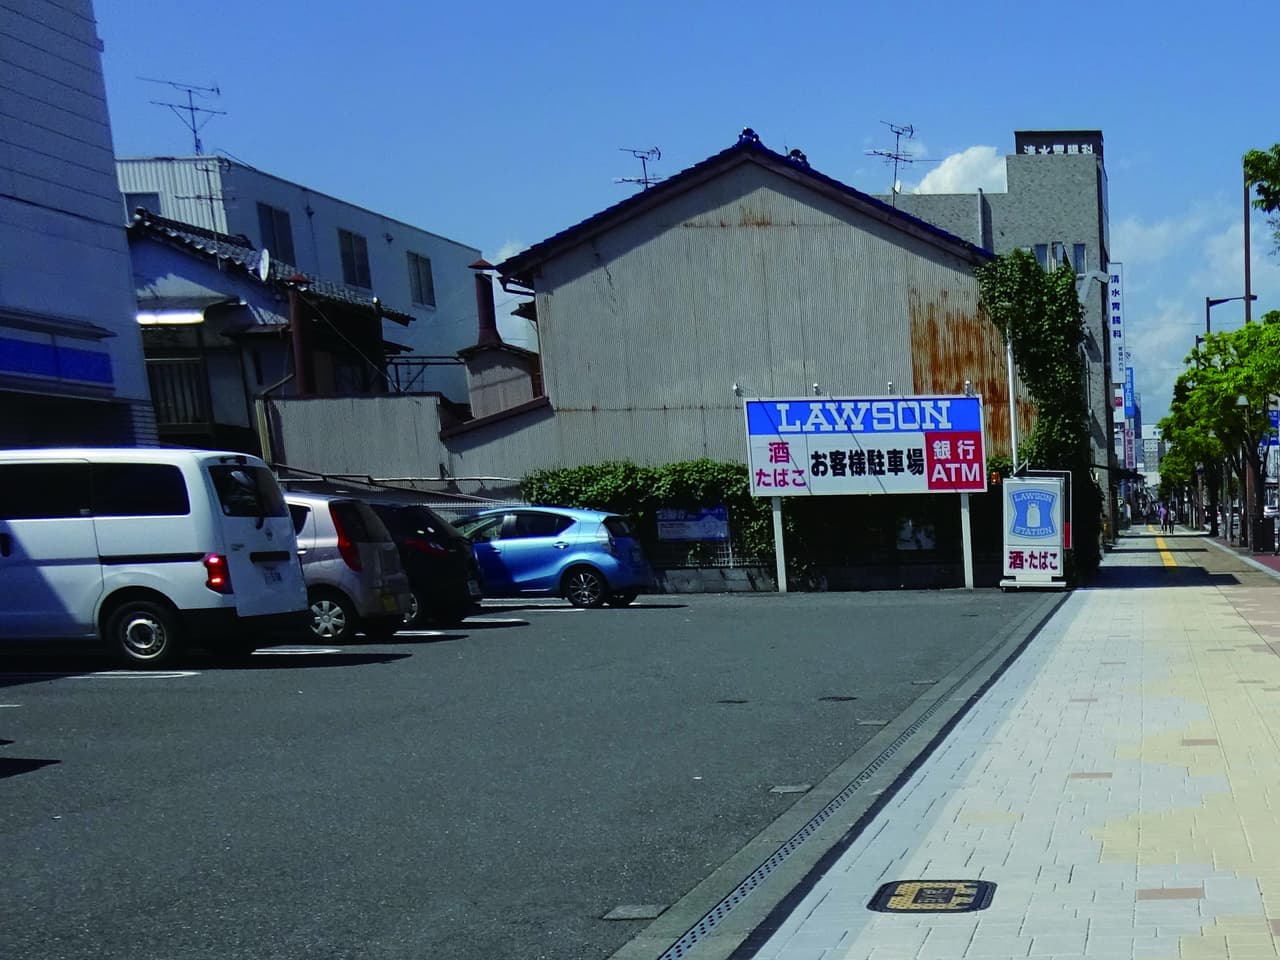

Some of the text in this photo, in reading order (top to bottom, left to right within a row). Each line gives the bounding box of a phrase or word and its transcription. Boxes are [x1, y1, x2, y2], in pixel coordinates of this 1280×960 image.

[776, 400, 952, 432] LAWSON
[768, 441, 790, 464] 酒
[932, 440, 975, 461] 銀行
[810, 447, 925, 477] お客様駐車場
[755, 467, 807, 489] たばこ
[931, 463, 980, 483] ATM
[1014, 491, 1053, 503] LAWSON
[1014, 526, 1053, 536] STATION
[1009, 550, 1058, 570] 酒・たばこ
